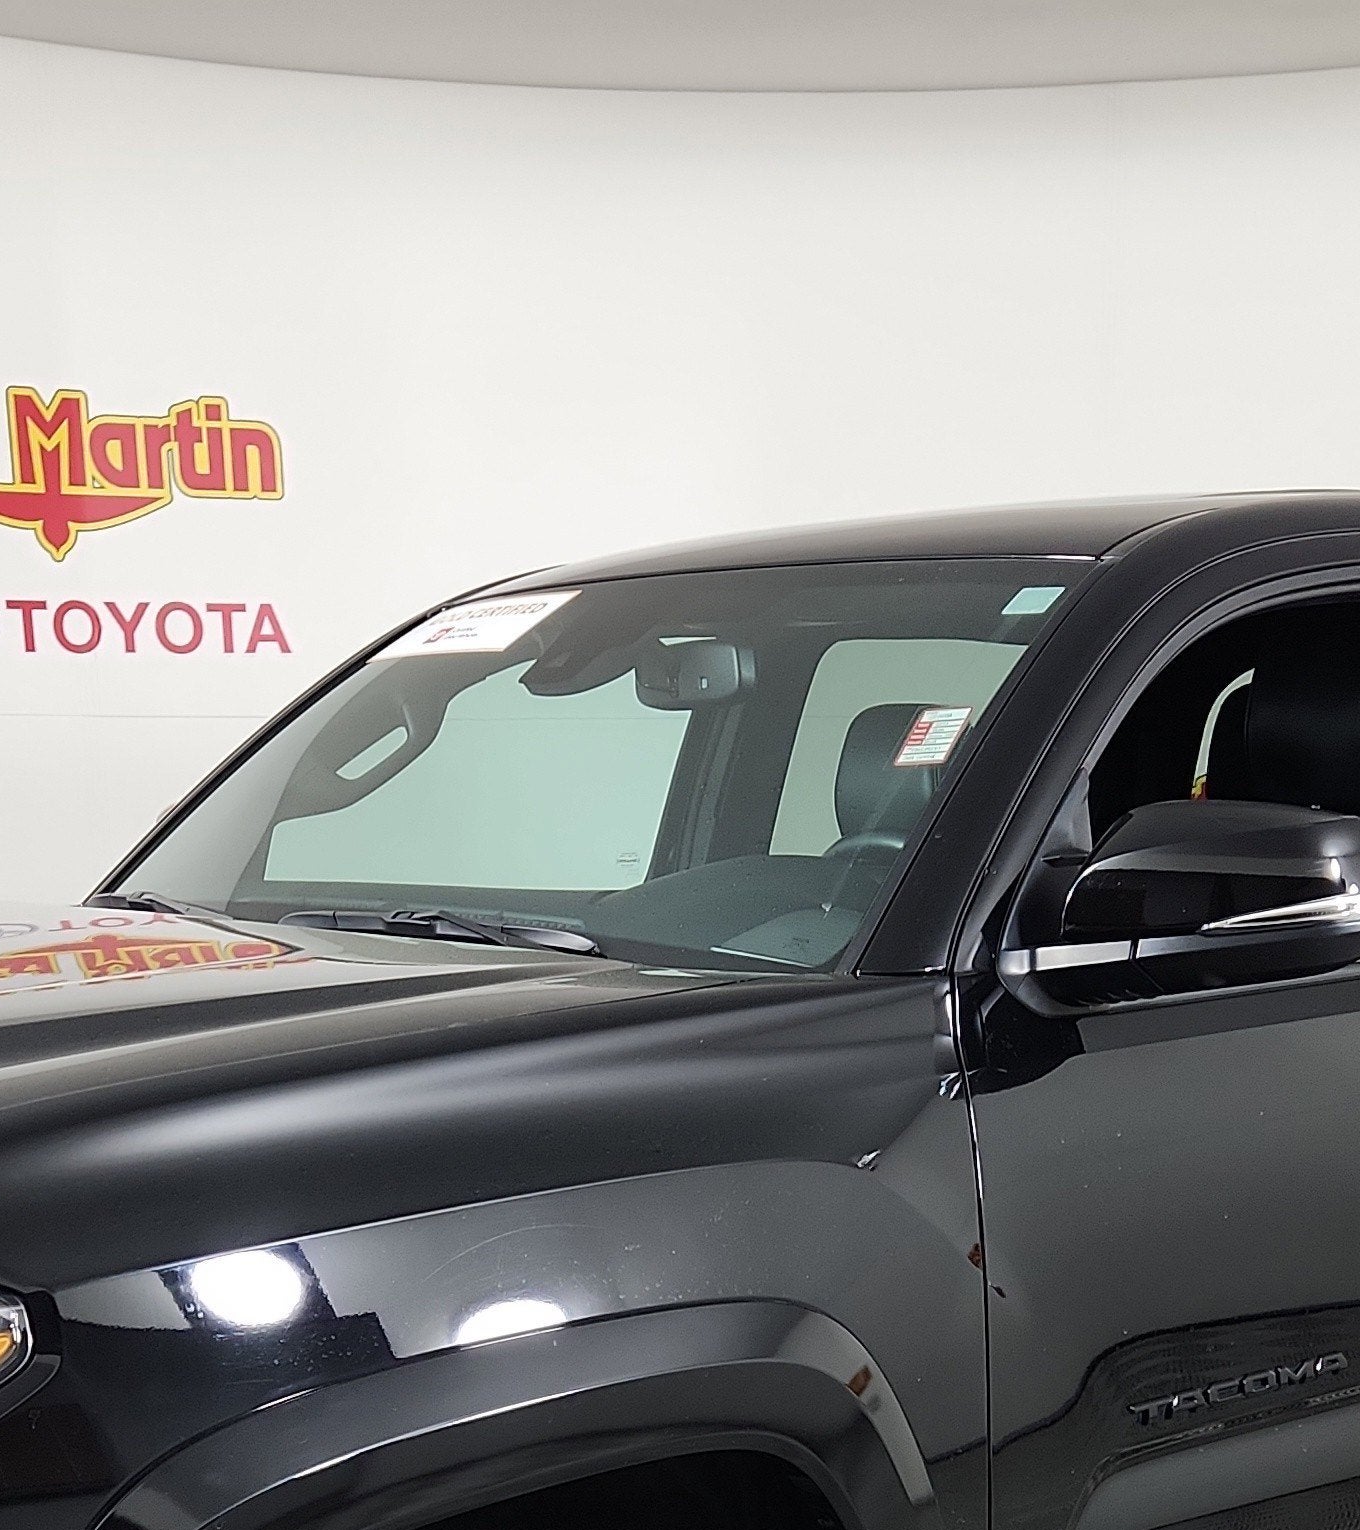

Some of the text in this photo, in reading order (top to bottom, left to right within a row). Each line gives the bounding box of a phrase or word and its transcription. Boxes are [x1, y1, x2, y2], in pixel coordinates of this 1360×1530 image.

[7, 385, 284, 505] Martin
[6, 599, 292, 655] TOYOTA
[1128, 1352, 1349, 1425] TACOMA
